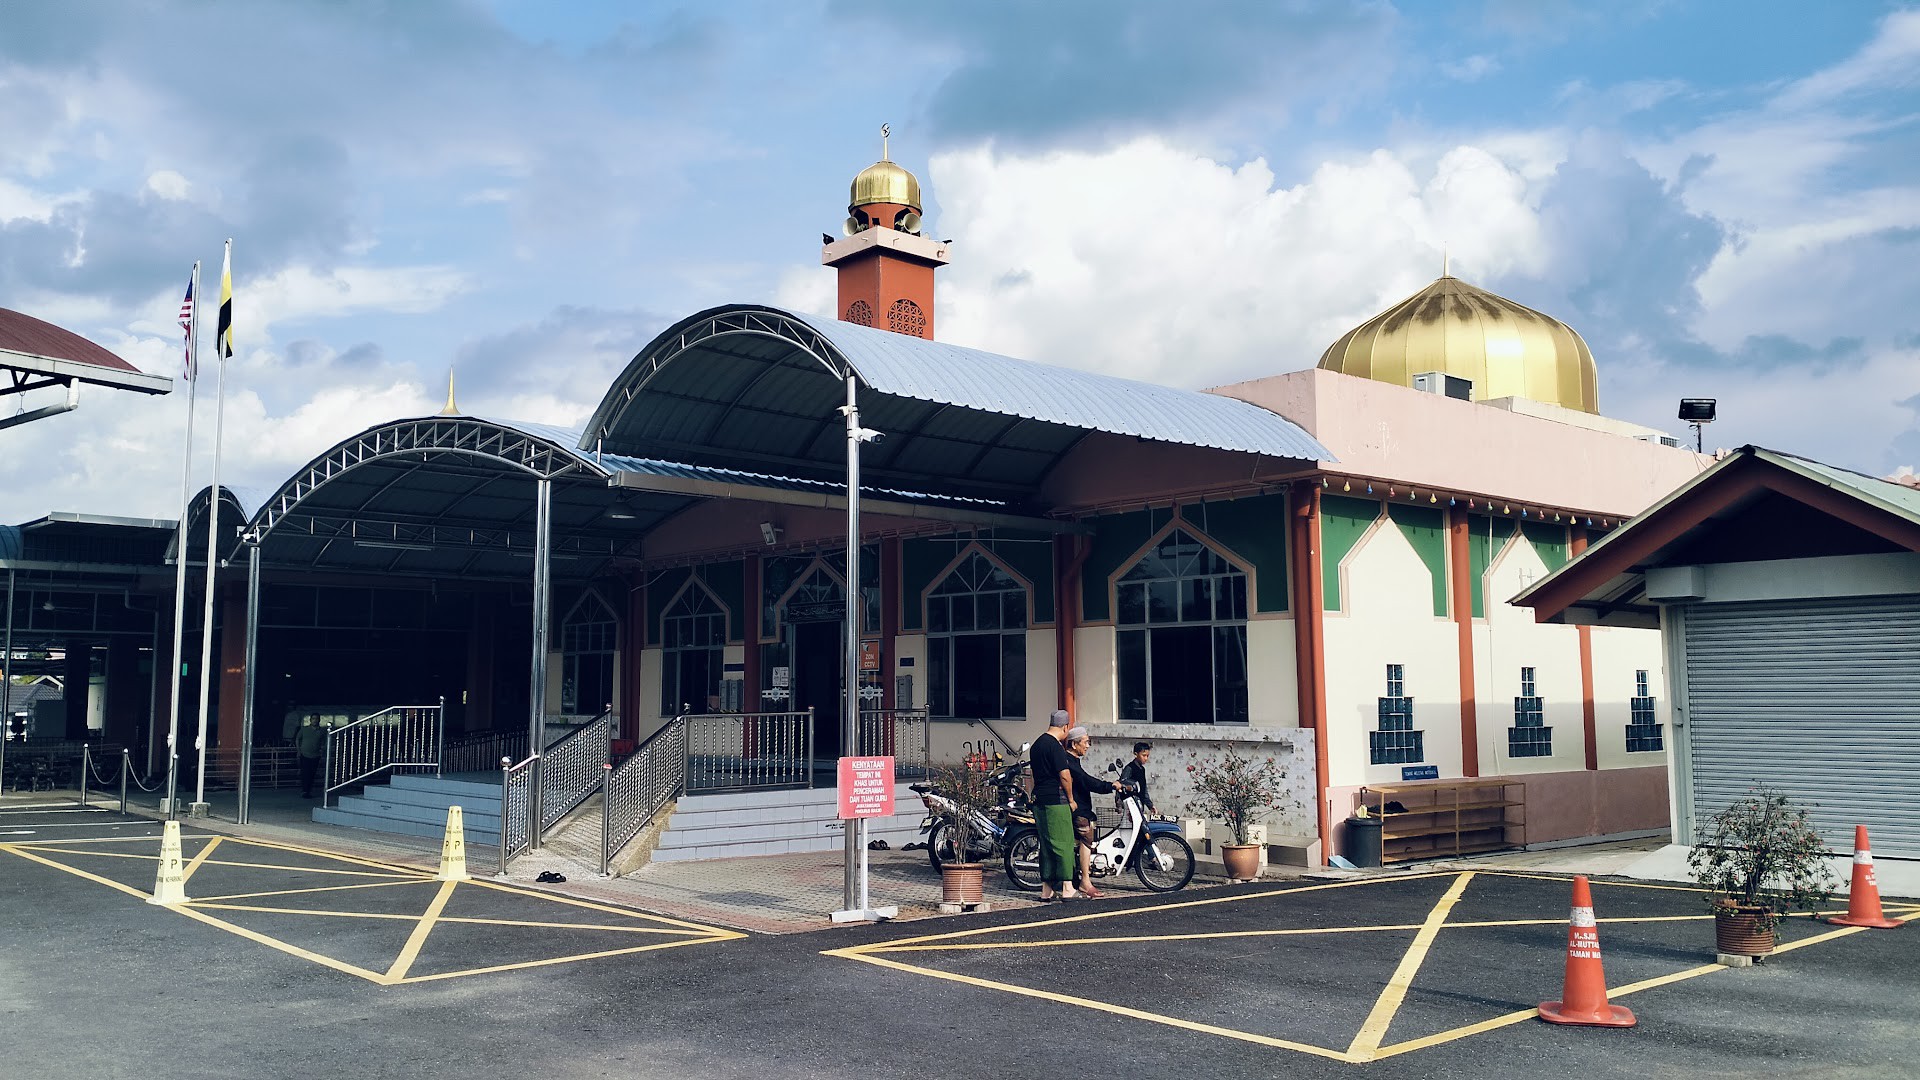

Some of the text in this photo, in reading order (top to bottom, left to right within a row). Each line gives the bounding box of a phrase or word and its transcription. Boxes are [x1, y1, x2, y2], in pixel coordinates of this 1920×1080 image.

[852, 761, 885, 770] KENYATAAN
[856, 771, 874, 779] TEMPAT
[868, 779, 884, 787] UNTUK
[854, 787, 884, 795] PENCERAMAH
[455, 841, 461, 850] P
[171, 859, 178, 869] P
[1570, 950, 1590, 958] TAMAN
